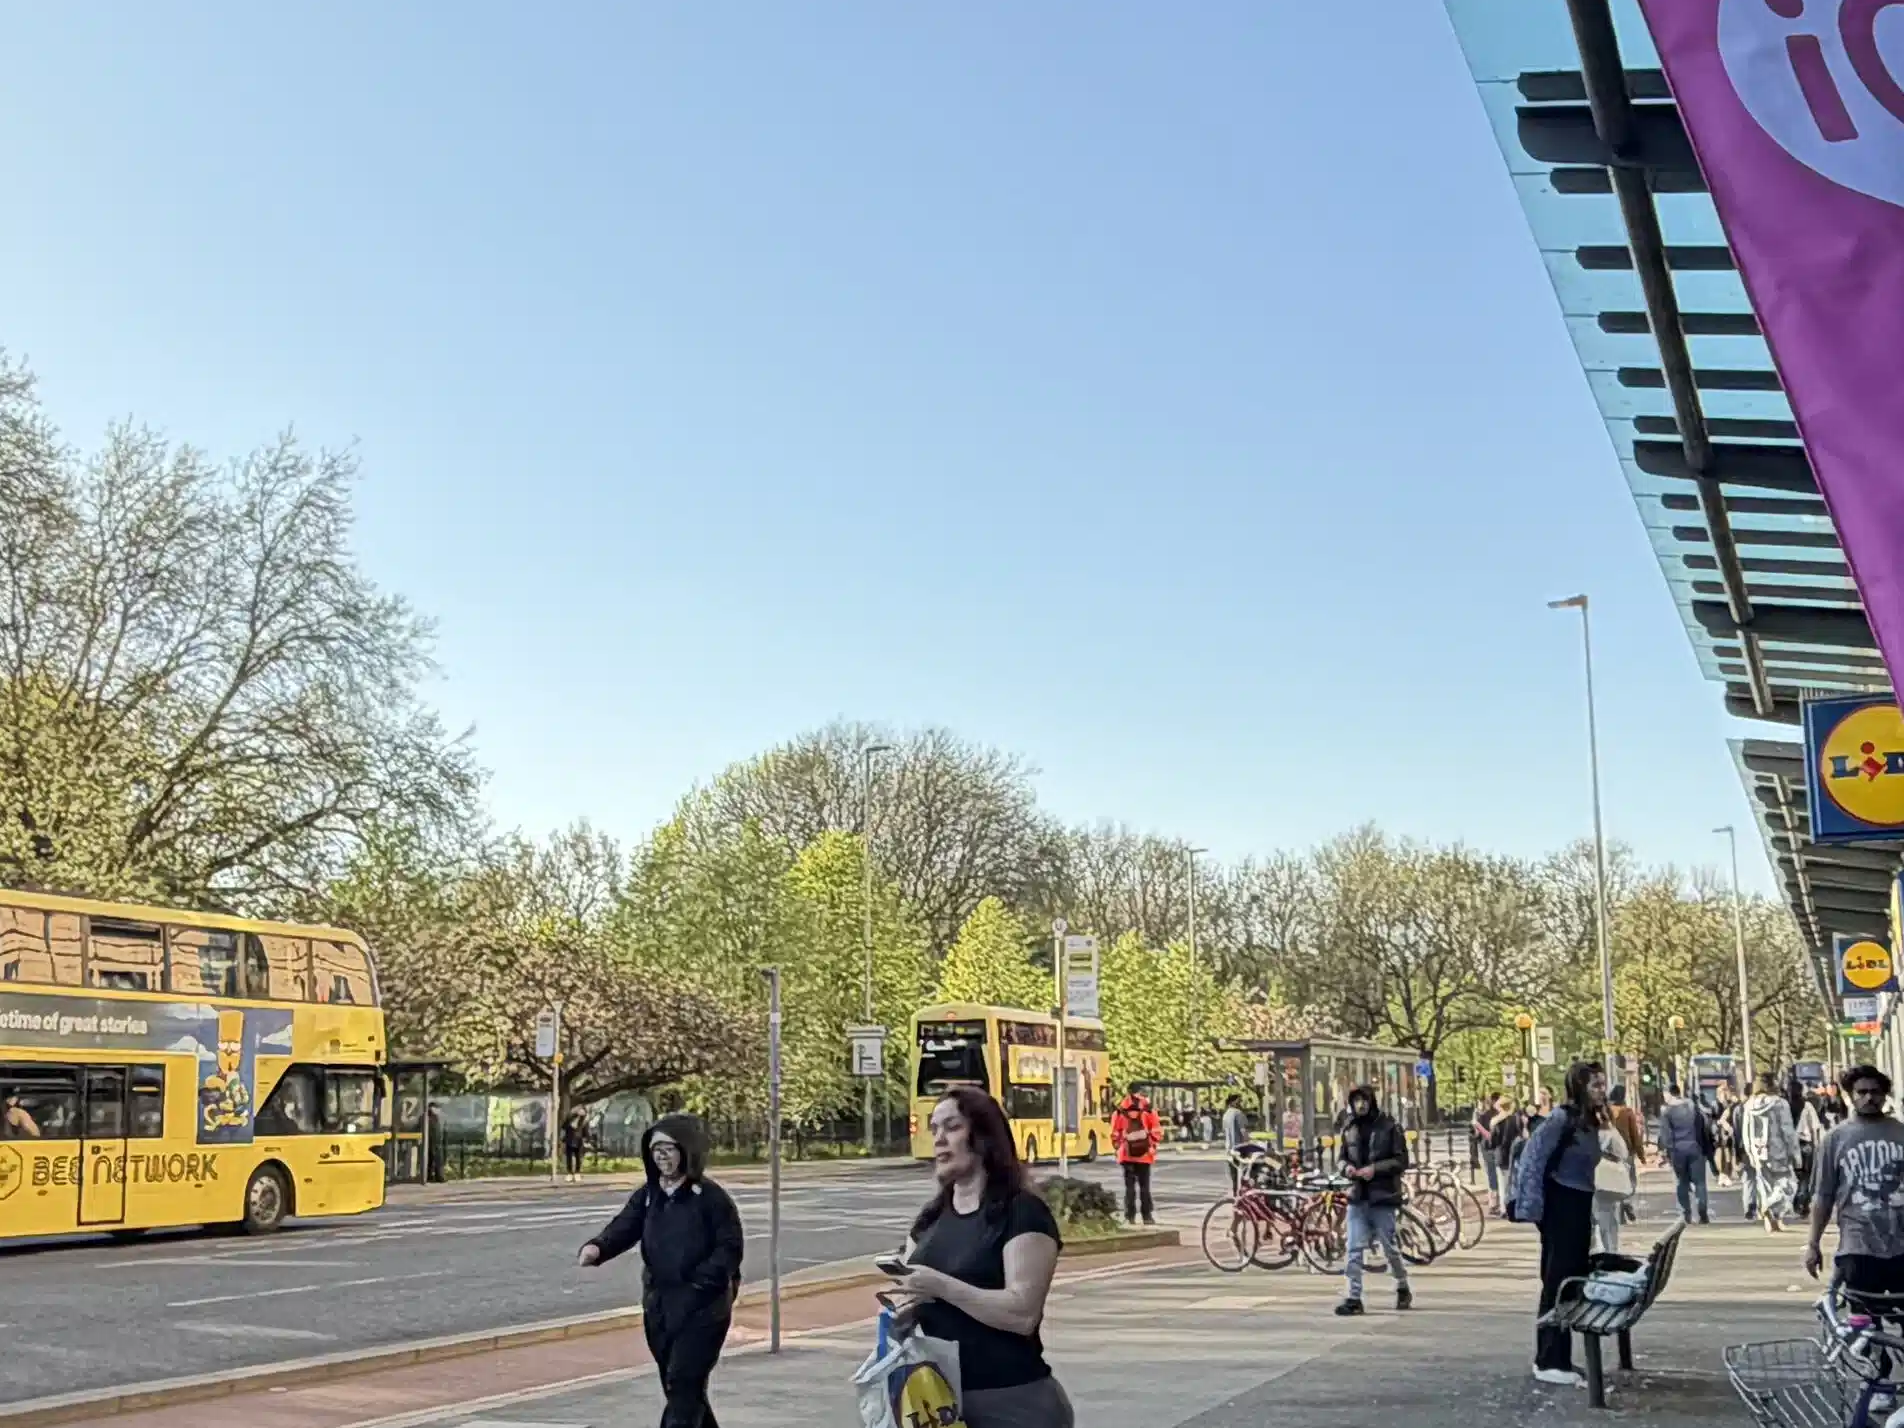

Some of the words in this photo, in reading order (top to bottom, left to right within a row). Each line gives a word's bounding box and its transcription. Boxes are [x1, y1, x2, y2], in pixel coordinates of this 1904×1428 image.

[43, 1011, 59, 1030] of
[59, 1014, 99, 1035] great
[100, 1014, 149, 1035] stories
